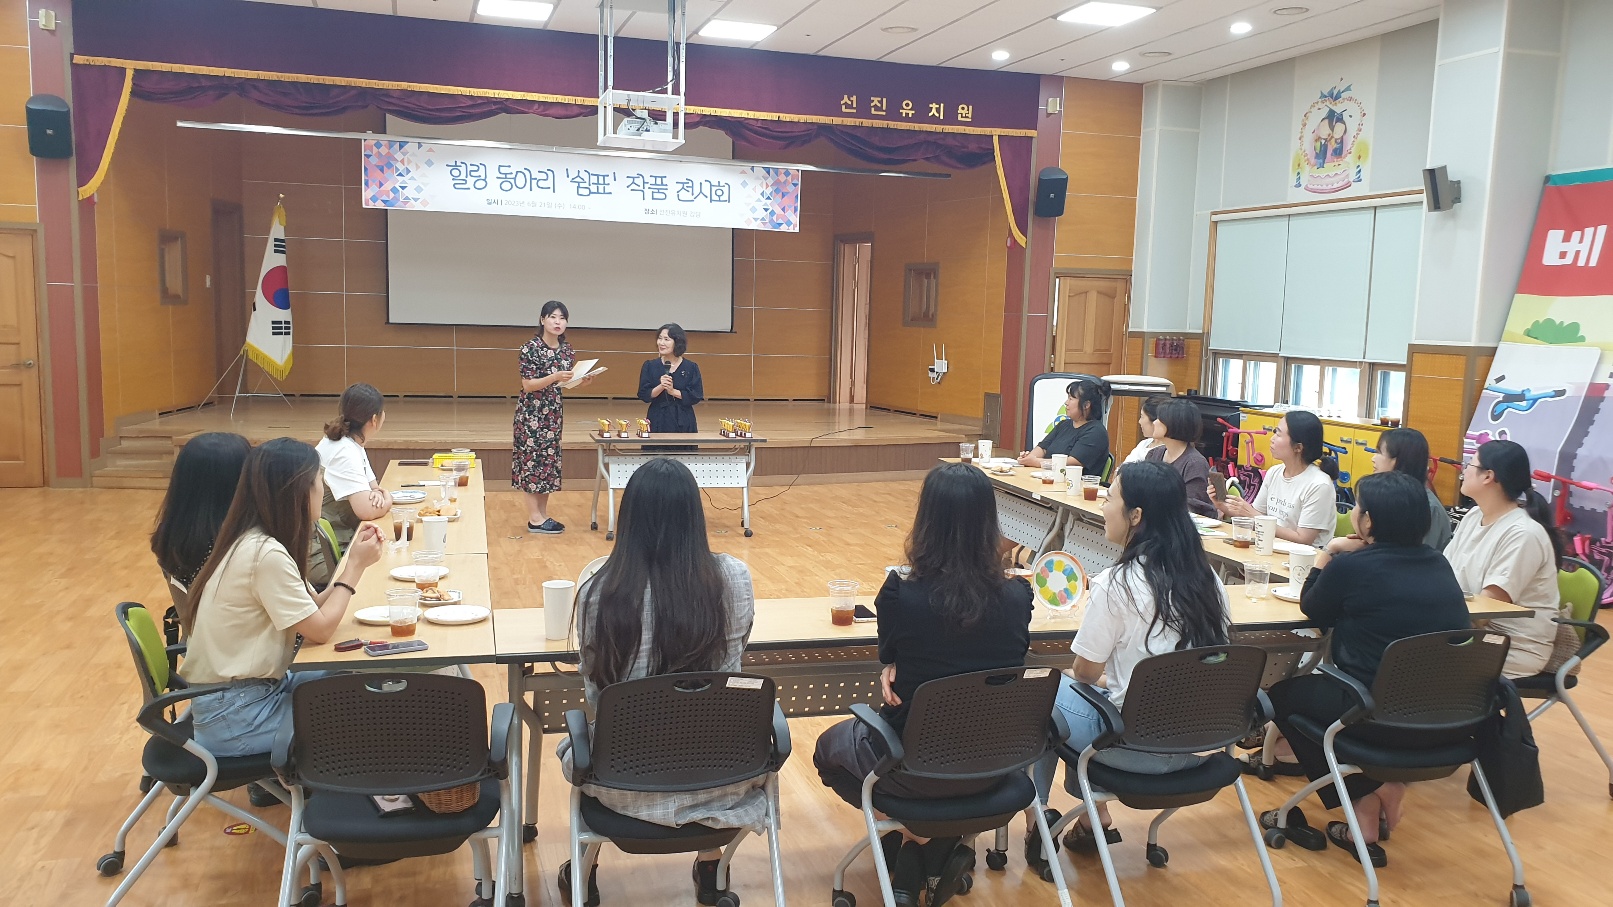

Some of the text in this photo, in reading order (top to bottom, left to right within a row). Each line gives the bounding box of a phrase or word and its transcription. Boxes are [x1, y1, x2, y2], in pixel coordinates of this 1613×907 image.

[840, 94, 973, 122] 선진유치원
[445, 160, 731, 203] 힐링 동아리 '쉼표' 작품 전시회
[1542, 225, 1607, 267] 베
